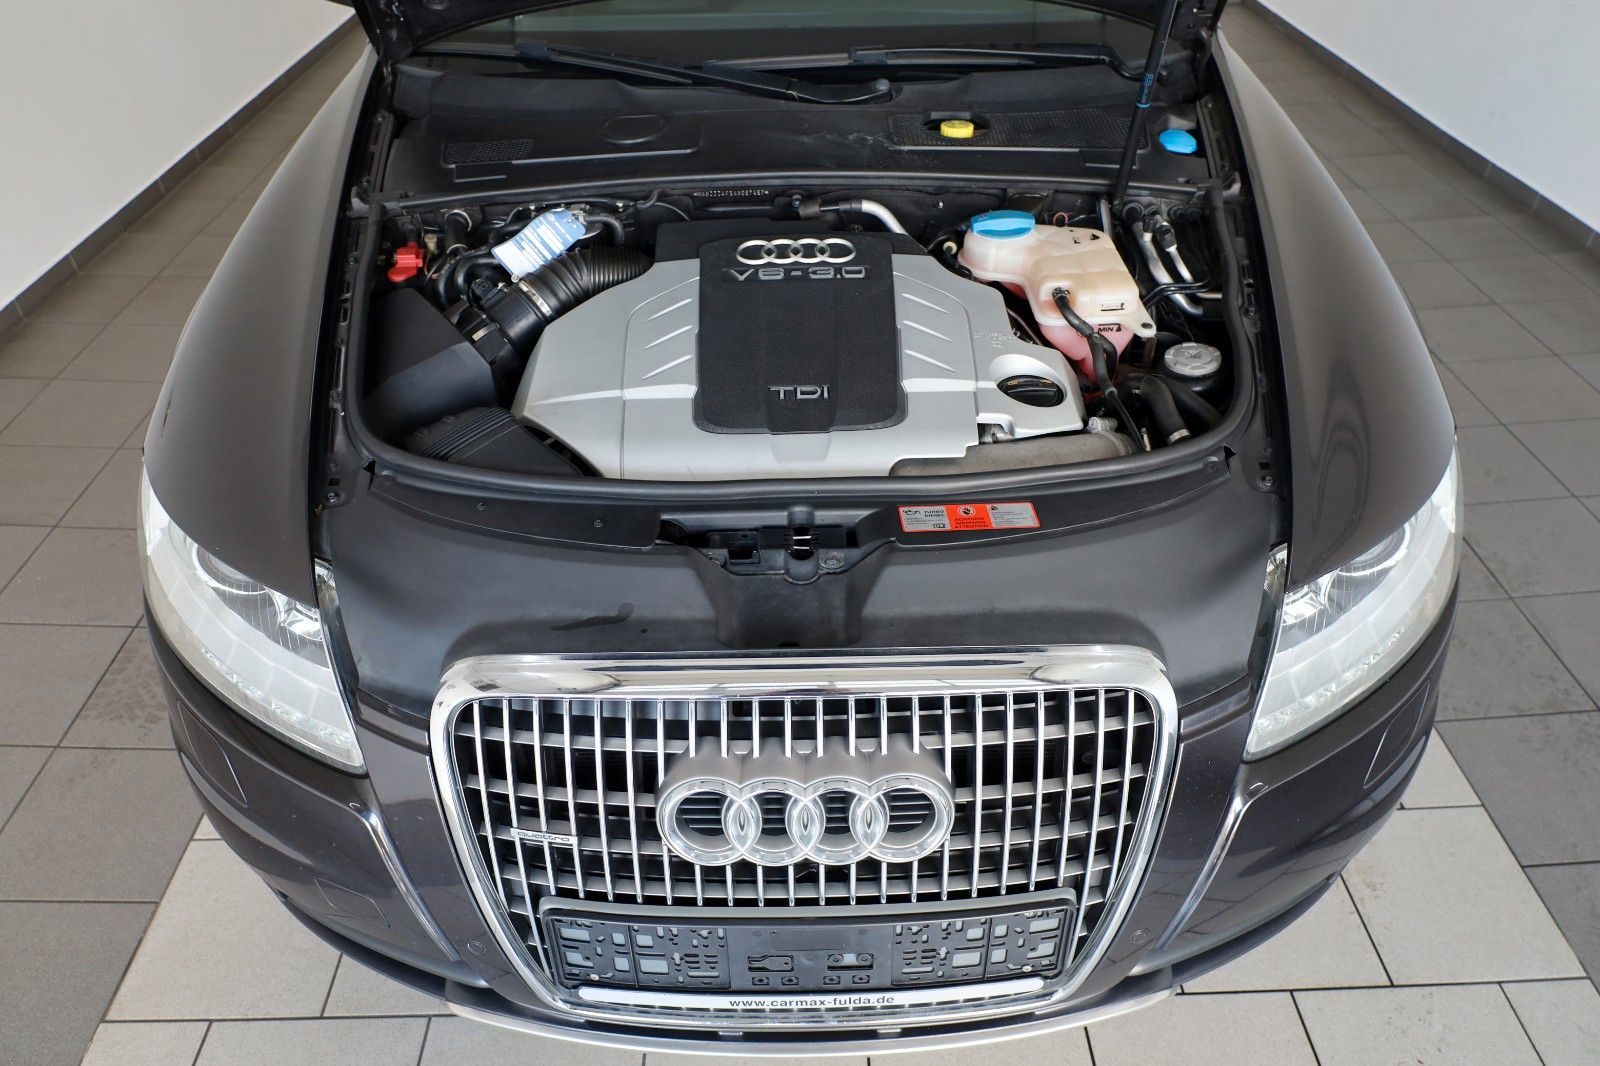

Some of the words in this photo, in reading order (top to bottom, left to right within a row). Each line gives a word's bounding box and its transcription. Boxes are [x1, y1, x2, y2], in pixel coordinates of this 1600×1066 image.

[769, 385, 830, 399] TDI
[517, 832, 570, 842] quattro
[729, 996, 895, 1007] www.carmax-fulda.de
